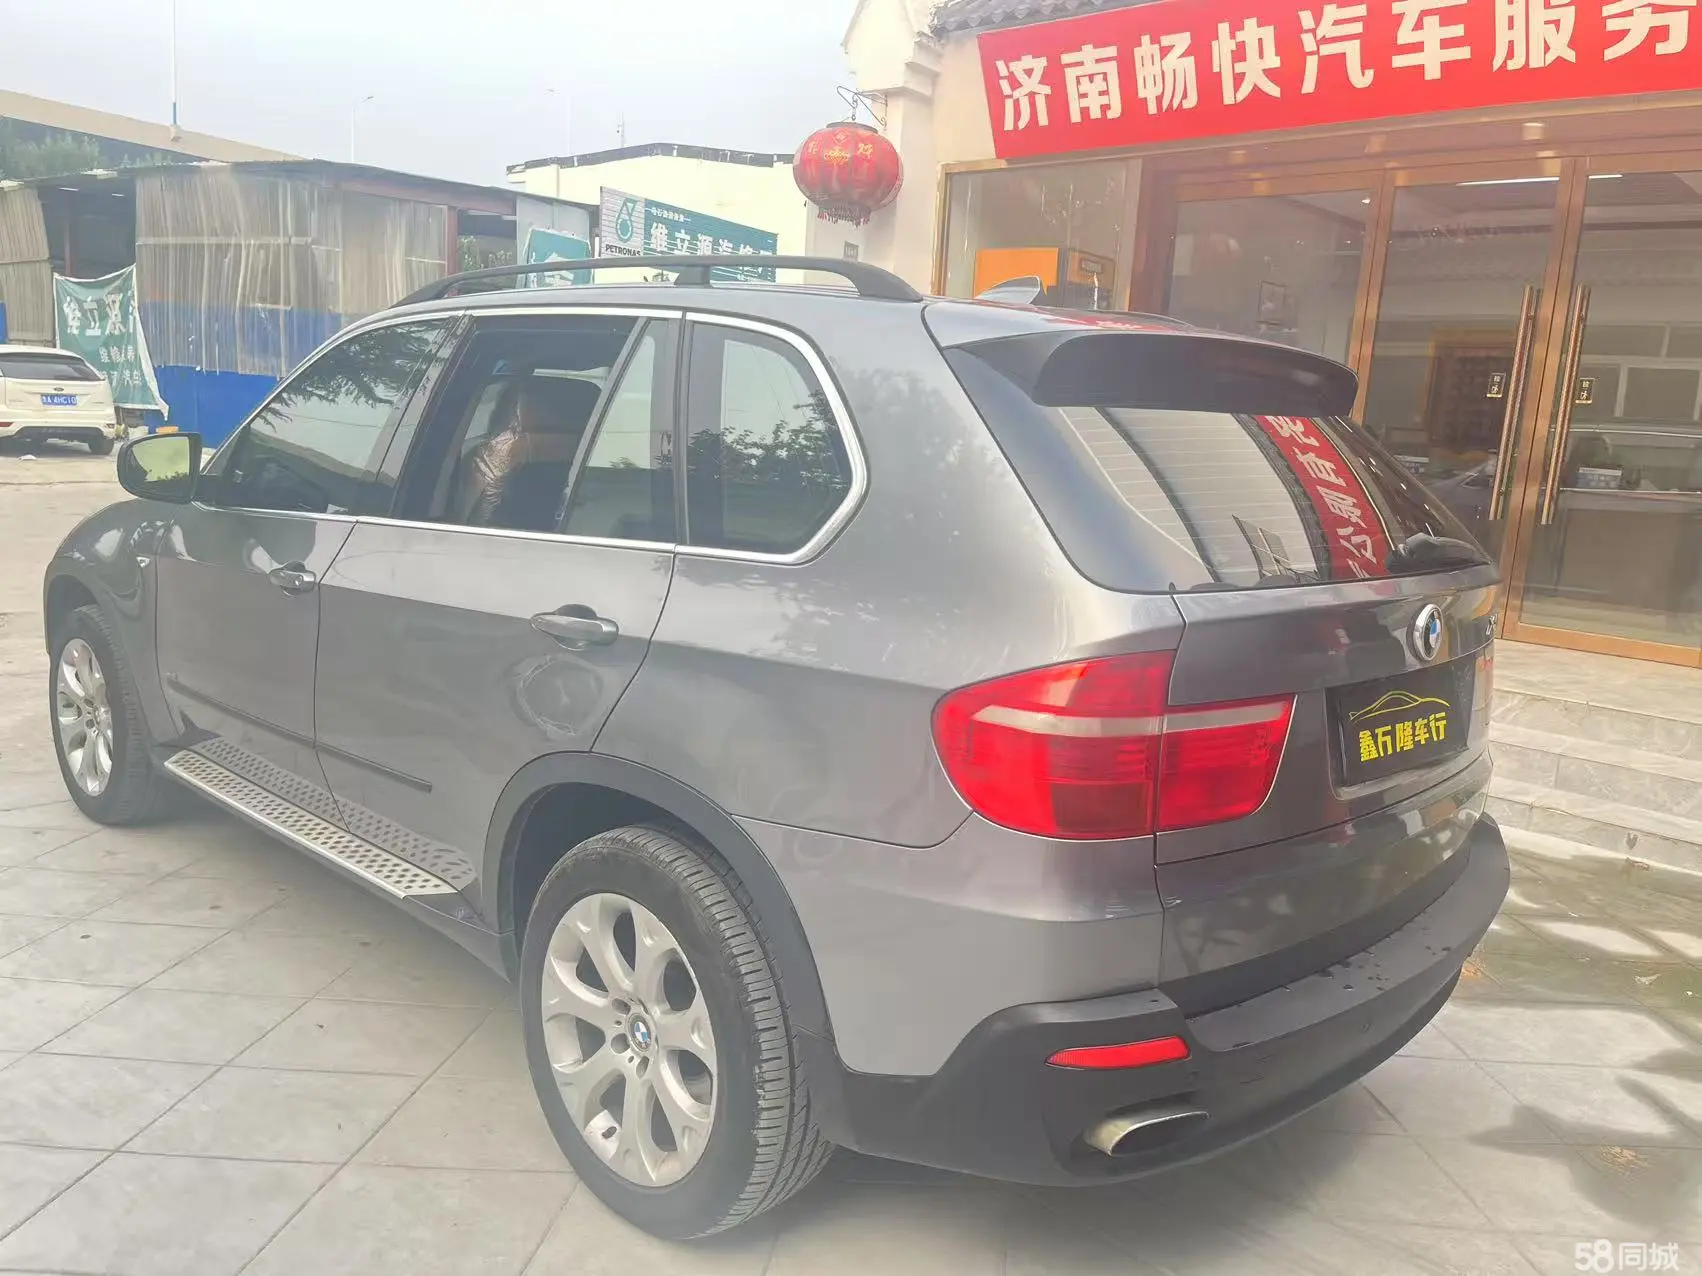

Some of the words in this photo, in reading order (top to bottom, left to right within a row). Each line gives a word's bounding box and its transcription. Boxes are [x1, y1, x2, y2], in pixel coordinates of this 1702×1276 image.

[995, 0, 1697, 131] 济南畅快汽车服务
[605, 243, 642, 257] PETRONAS
[1358, 711, 1447, 762] 鑫万隆车行
